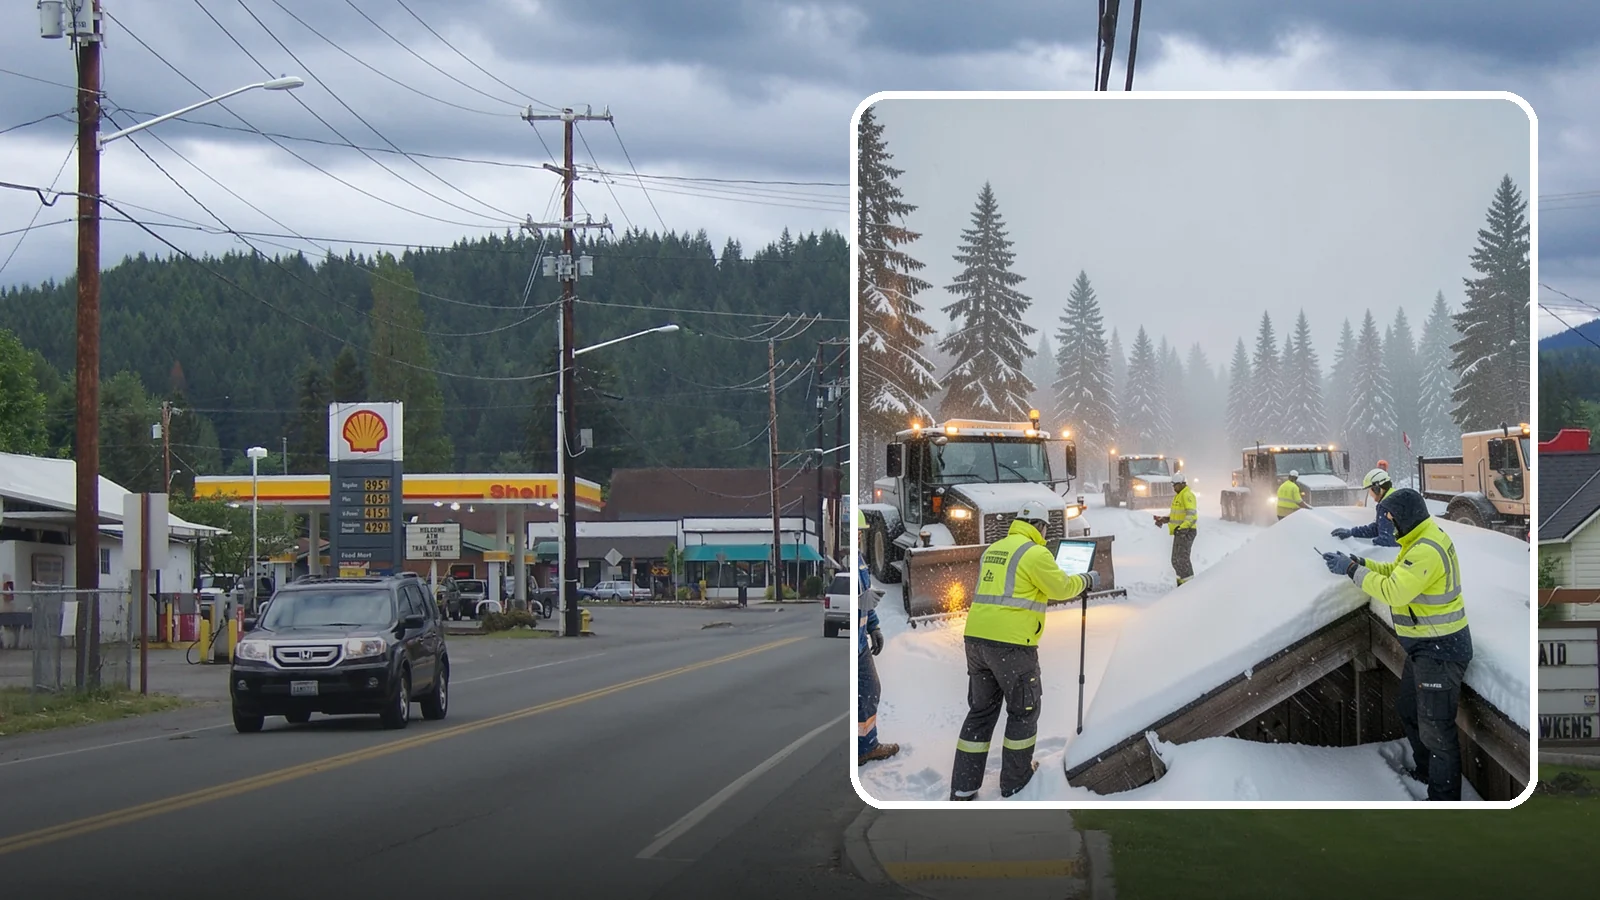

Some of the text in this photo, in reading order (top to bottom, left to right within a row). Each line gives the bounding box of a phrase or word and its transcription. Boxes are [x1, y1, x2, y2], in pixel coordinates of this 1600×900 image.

[366, 480, 384, 490] 395
[490, 484, 547, 499] Shell
[366, 494, 384, 504] 405
[366, 508, 384, 518] 415
[366, 522, 384, 532] 429
[1538, 643, 1567, 665] AID
